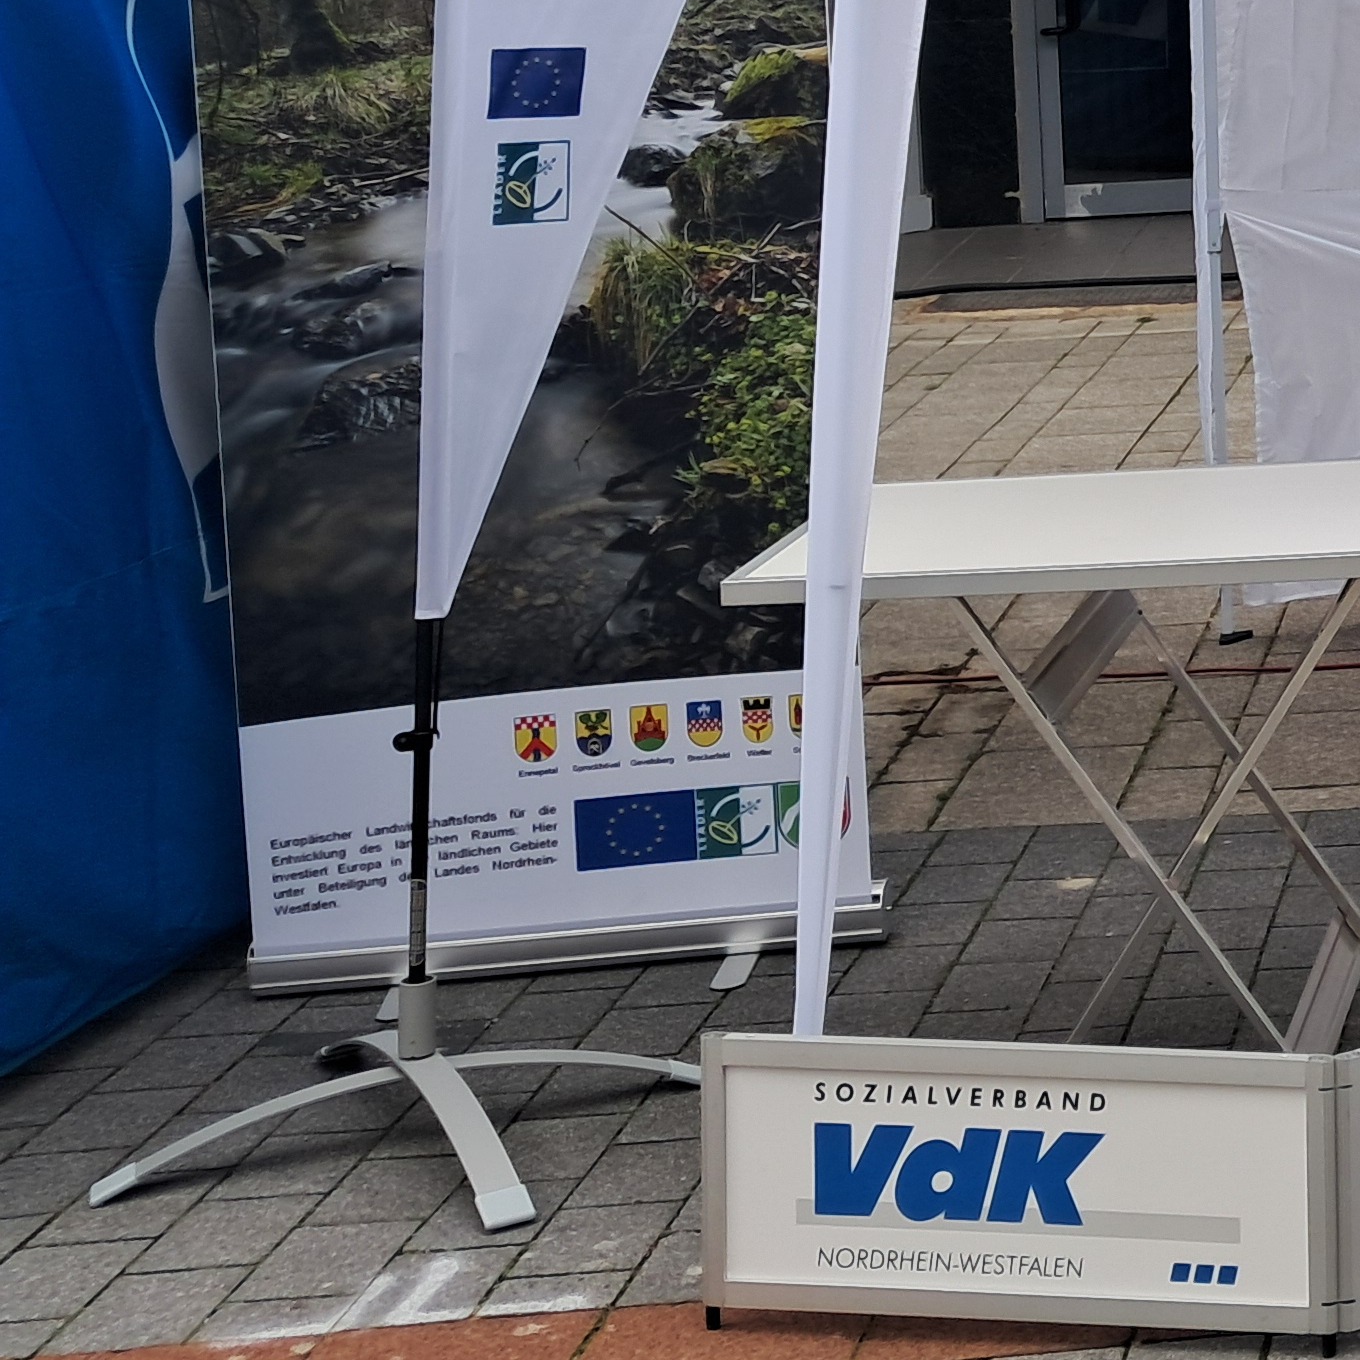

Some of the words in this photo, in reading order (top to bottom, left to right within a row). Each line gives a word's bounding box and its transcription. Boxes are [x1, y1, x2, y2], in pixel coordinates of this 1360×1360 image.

[509, 808, 525, 819] für
[538, 805, 557, 816] die
[360, 844, 382, 855] des
[532, 822, 558, 833] Hier
[338, 860, 382, 875] Europa
[390, 857, 402, 867] in
[509, 838, 558, 852] Gebiete
[273, 887, 305, 899] unter
[434, 864, 480, 878] Landes
[814, 1081, 1107, 1113] SOZIALVERBAND
[814, 1122, 1106, 1227] VdK
[817, 1246, 1085, 1280] NORDRHEIN-WESTFALEN
